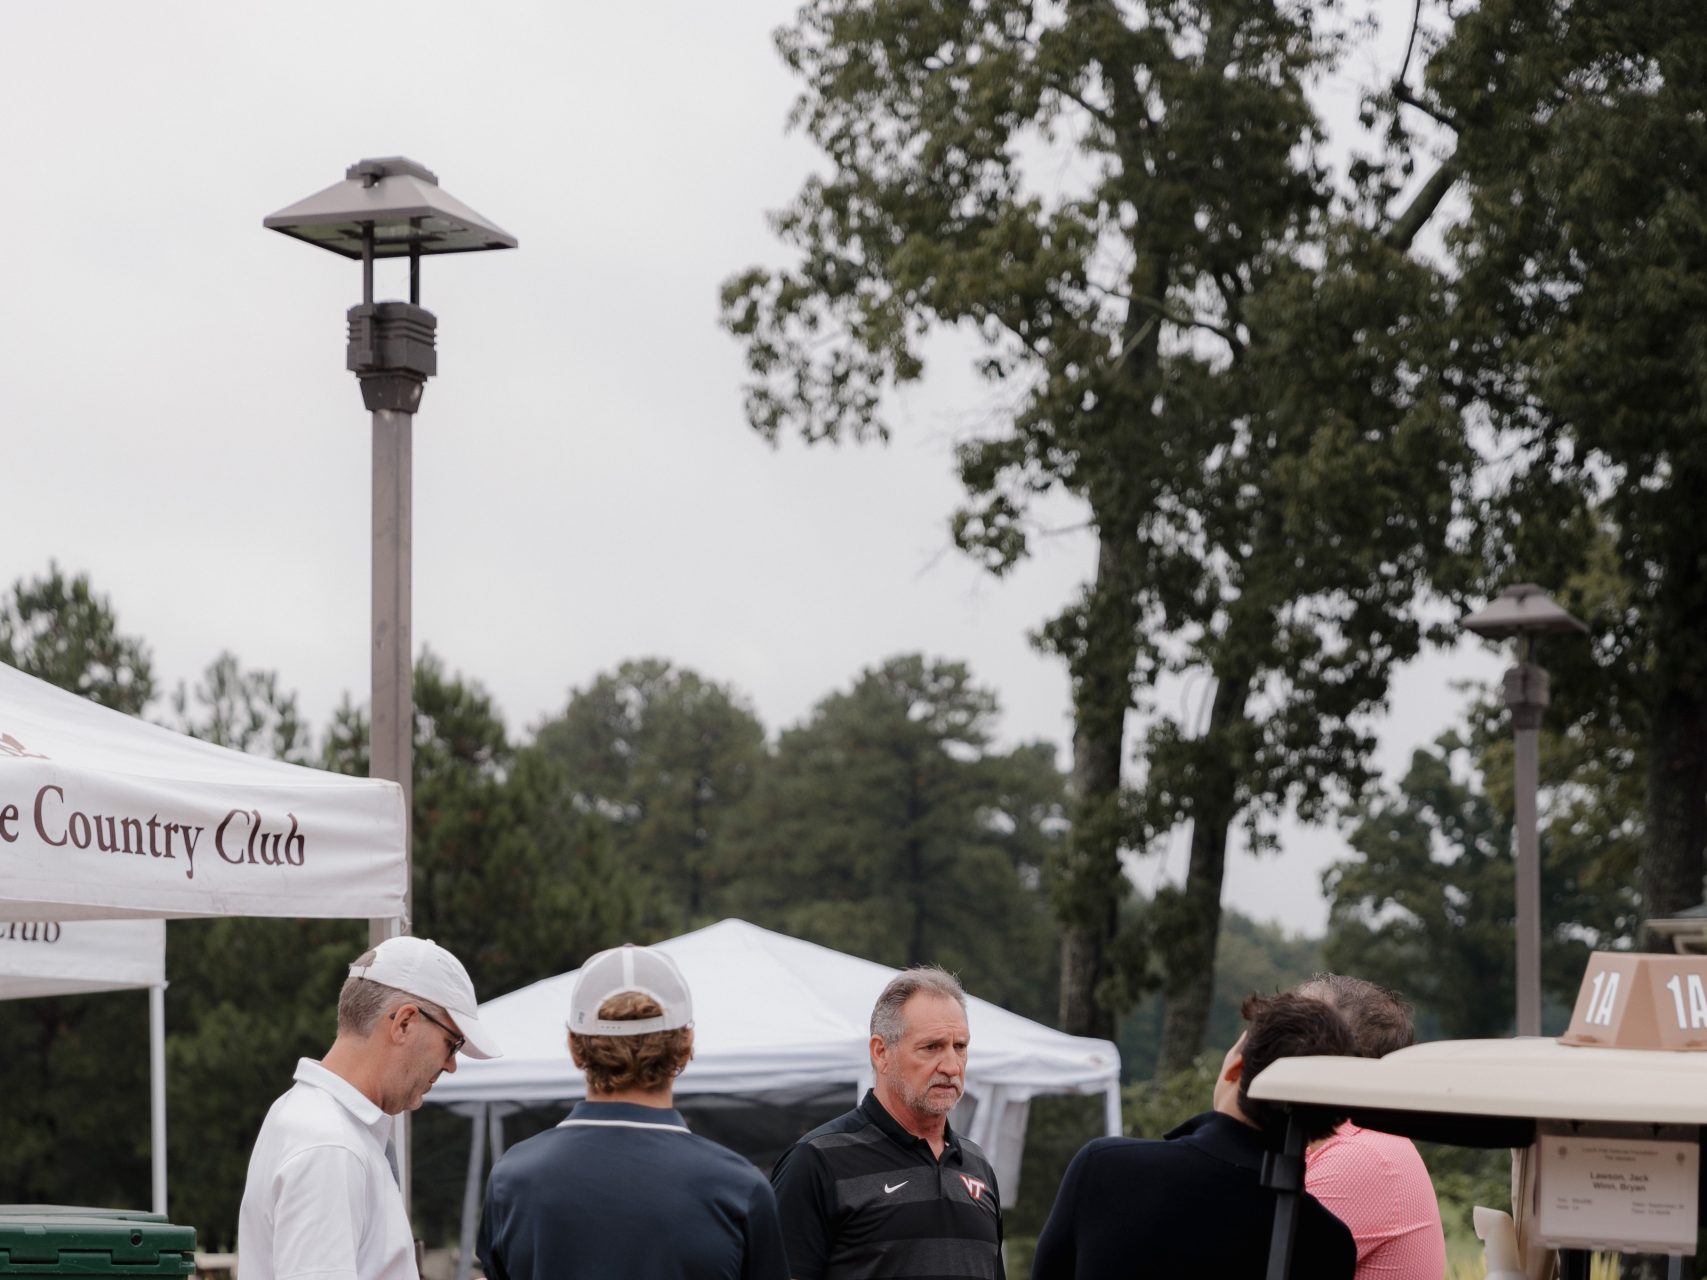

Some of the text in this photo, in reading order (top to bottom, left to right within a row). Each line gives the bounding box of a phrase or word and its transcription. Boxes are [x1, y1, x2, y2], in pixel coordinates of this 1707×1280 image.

[33, 784, 204, 880] Country
[214, 808, 306, 867] Club
[0, 921, 62, 943] lub
[1585, 970, 1620, 1026] 1A
[1666, 973, 1707, 1030] 1A
[959, 1173, 986, 1200] VT
